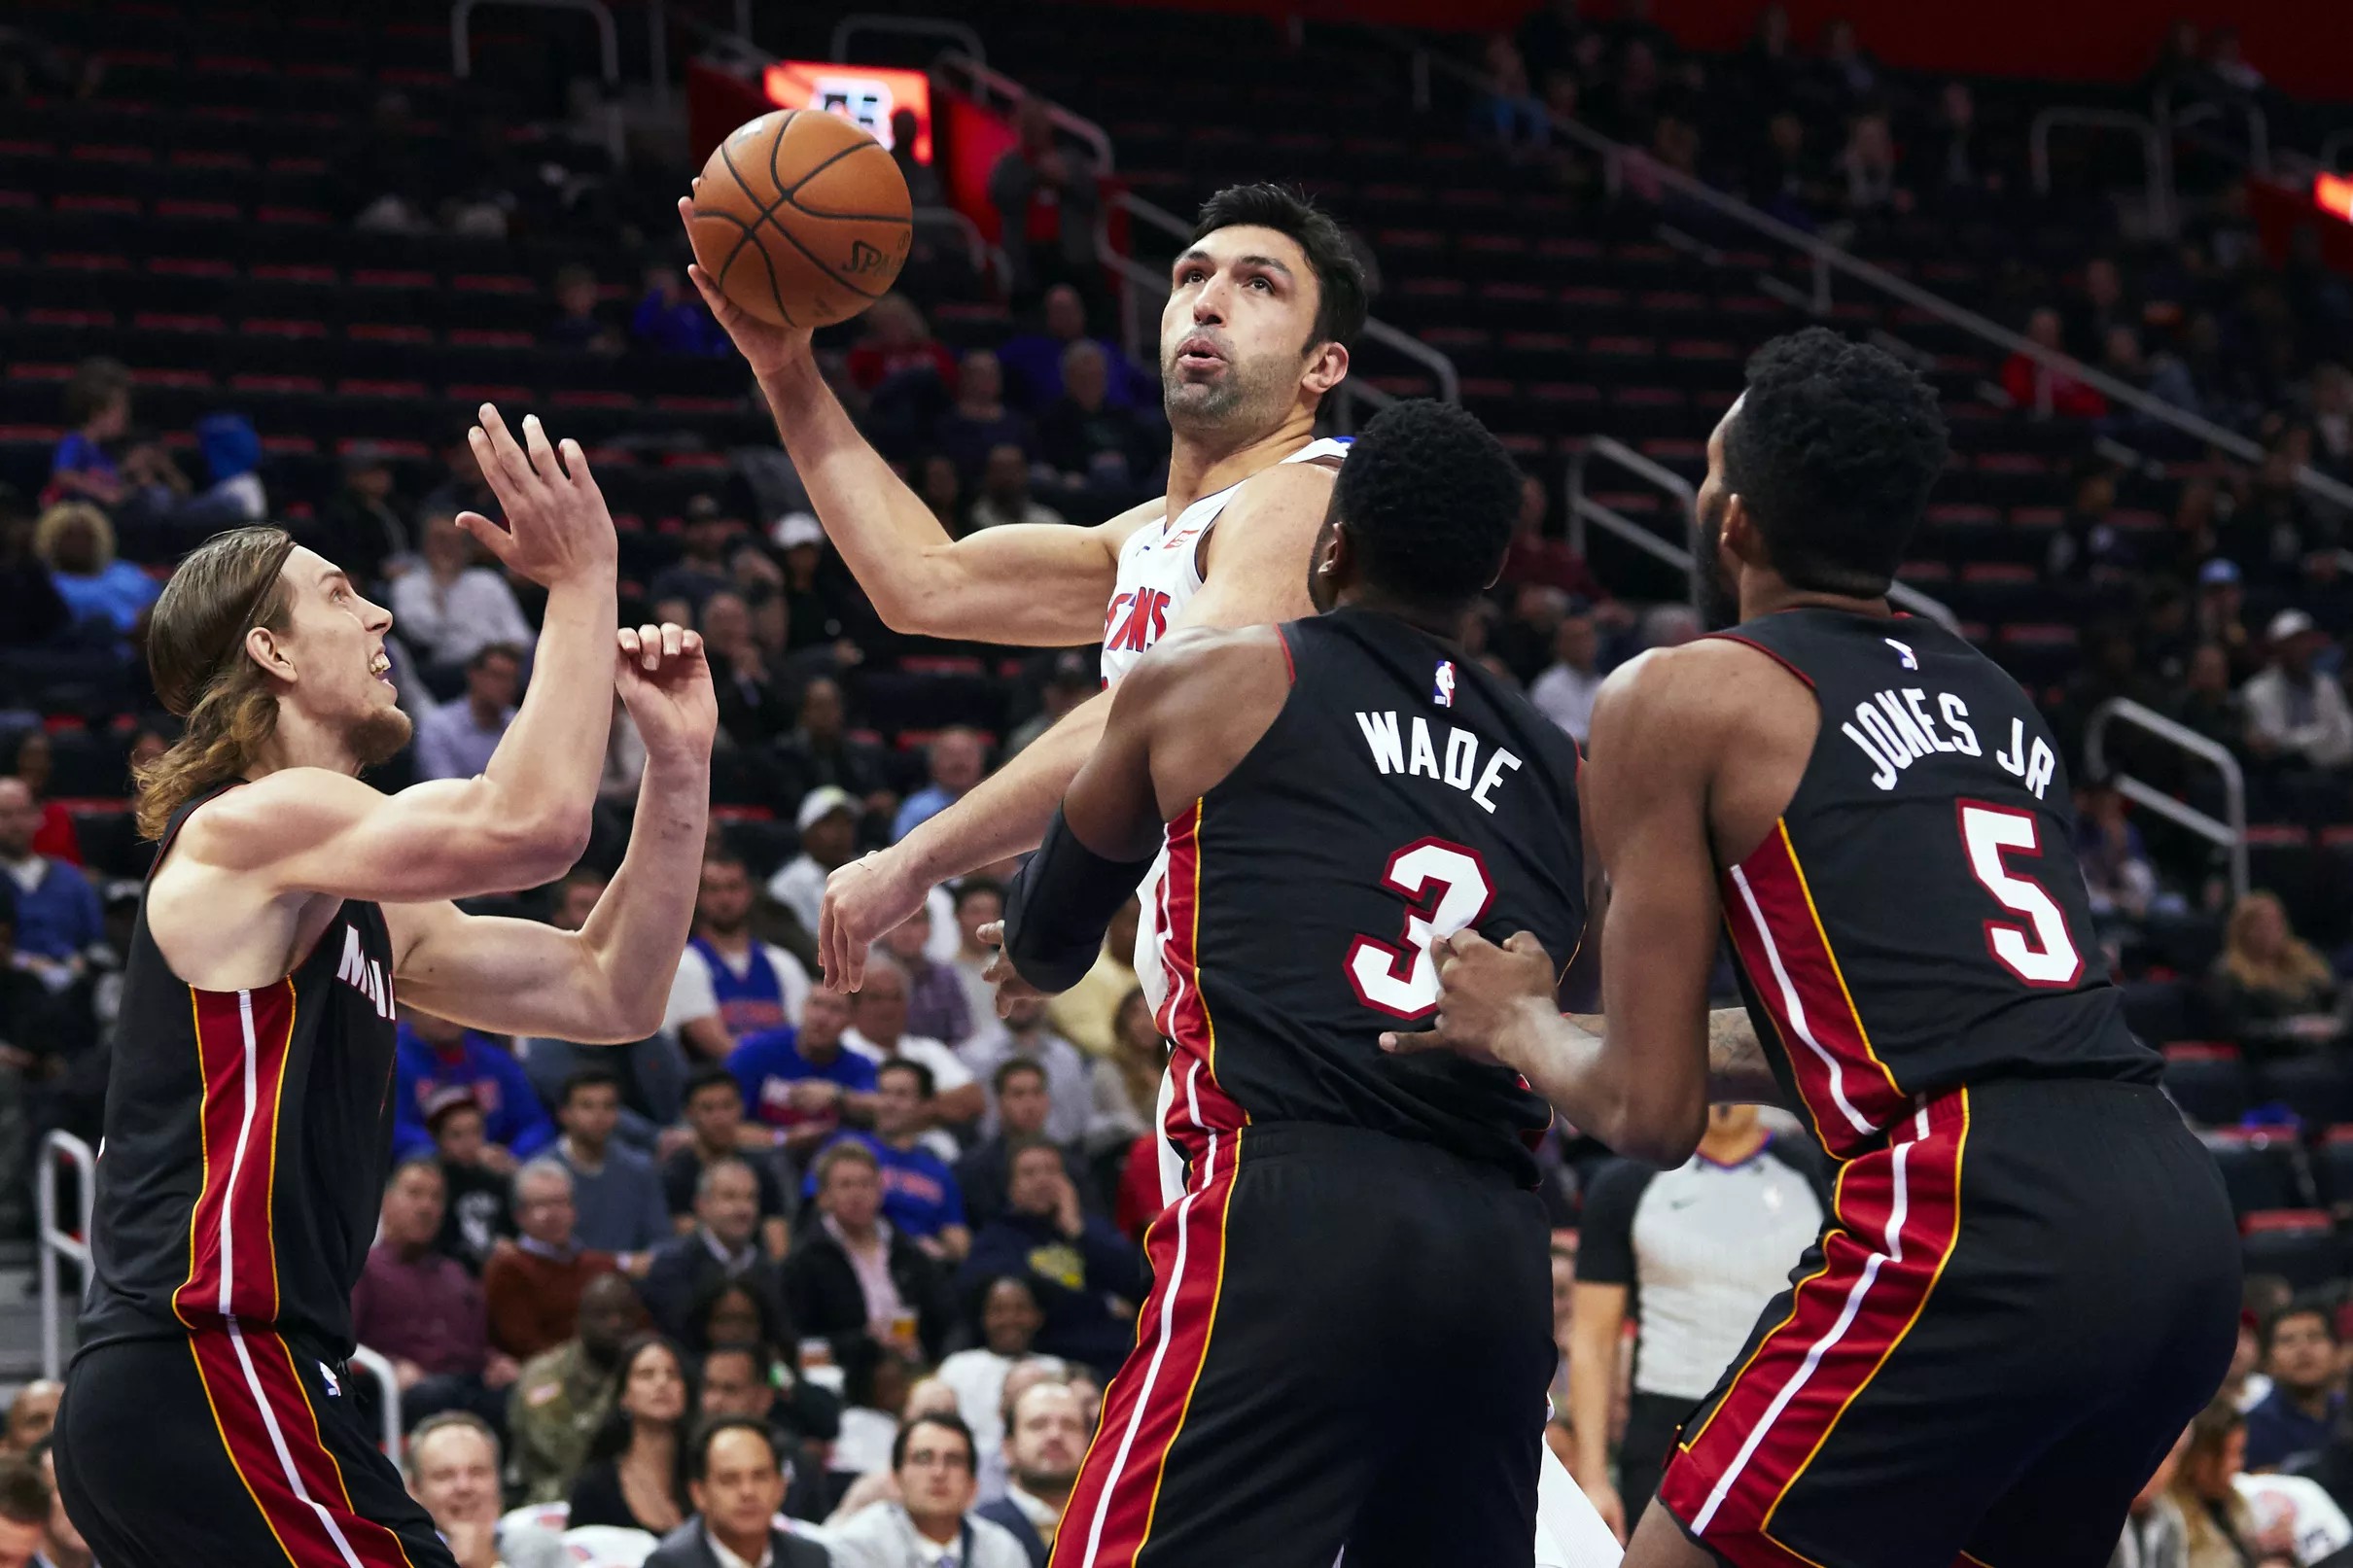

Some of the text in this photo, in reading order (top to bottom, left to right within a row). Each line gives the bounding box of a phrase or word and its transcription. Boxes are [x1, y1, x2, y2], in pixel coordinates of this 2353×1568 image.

[1355, 711, 1523, 815] WADE
[1842, 688, 2055, 800] JONES JR
[1343, 836, 1497, 1021] 3
[1955, 797, 2086, 989] 5
